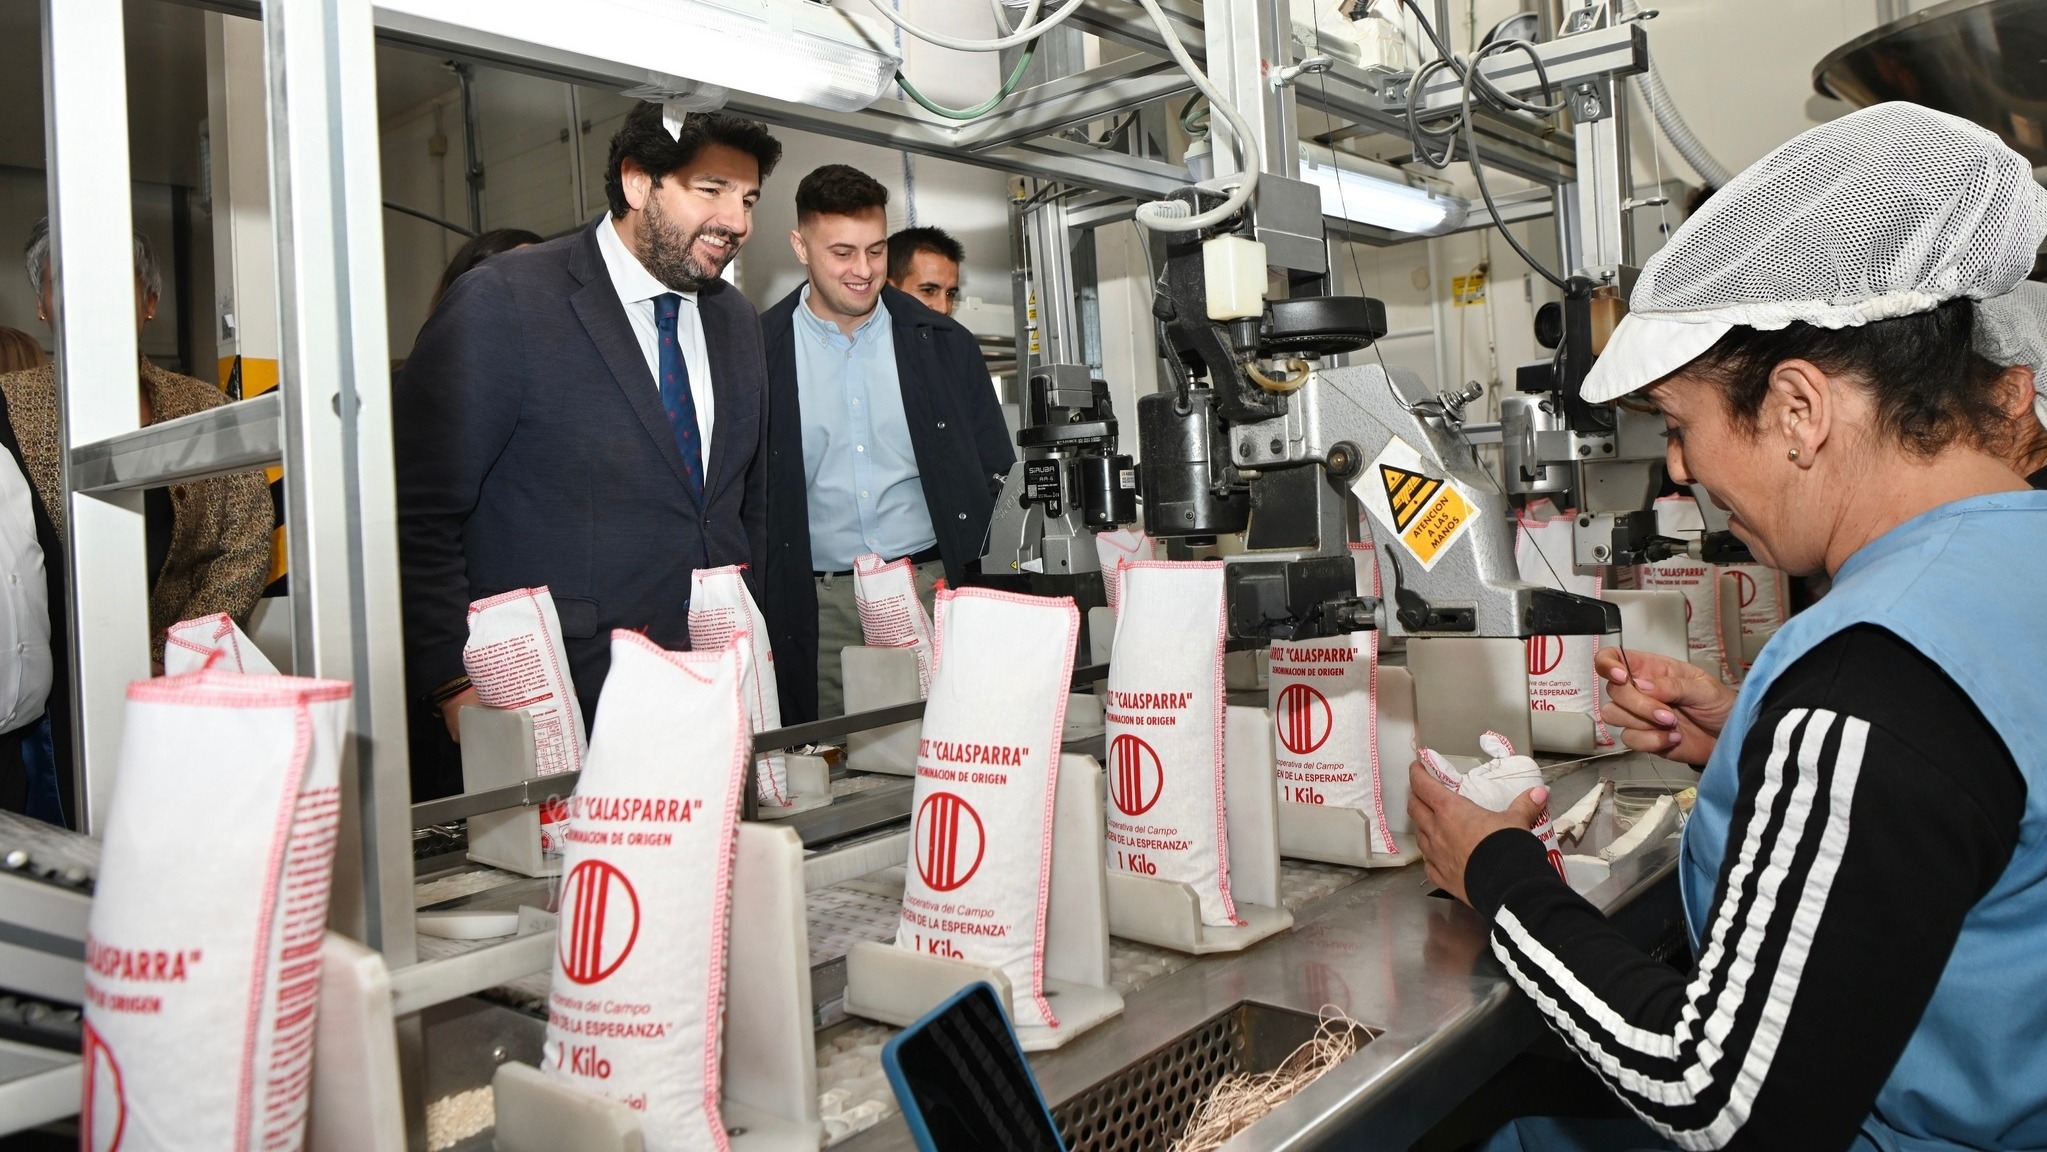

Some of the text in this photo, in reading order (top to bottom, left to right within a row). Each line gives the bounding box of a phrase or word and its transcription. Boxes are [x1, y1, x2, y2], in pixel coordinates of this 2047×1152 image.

[1413, 496, 1449, 538] ATENCION
[1428, 512, 1449, 537] A LAS
[1431, 516, 1460, 549] MANOS
[1286, 647, 1358, 662] "CALASPARRA"
[1308, 668, 1316, 676] DE
[1318, 668, 1344, 676] ORIGEN
[1115, 691, 1193, 709] "CALASPARRA"
[1540, 688, 1581, 696] ESPERANZA"
[1136, 717, 1144, 725] DE
[1146, 716, 1176, 726] ORIGEN
[932, 741, 1029, 766] "CALASPARRA"
[1316, 762, 1344, 771] Campo
[958, 771, 969, 783] DE
[971, 772, 1007, 785] ORIGEN
[1285, 770, 1293, 780] DE
[1294, 772, 1304, 781] LA
[1305, 773, 1357, 782] ESPERANZA"
[1284, 785, 1324, 805] 1 Kilo
[585, 797, 702, 822] "CALASPARRA"
[611, 833, 622, 845] DE
[627, 832, 672, 846] ORIGEN
[1135, 825, 1146, 834] del
[1147, 826, 1178, 837] Campo
[1117, 834, 1126, 844] DE
[1126, 836, 1136, 846] LA
[1118, 850, 1157, 875] 1 Kilo
[942, 903, 955, 914] del
[957, 904, 995, 919] Campo
[917, 914, 927, 927] DE
[928, 917, 940, 930] LA
[914, 934, 920, 951] 1
[585, 1000, 601, 1012] del
[603, 1000, 651, 1016] Campo
[570, 1019, 582, 1033] LA
[571, 1045, 611, 1080] Kilo
